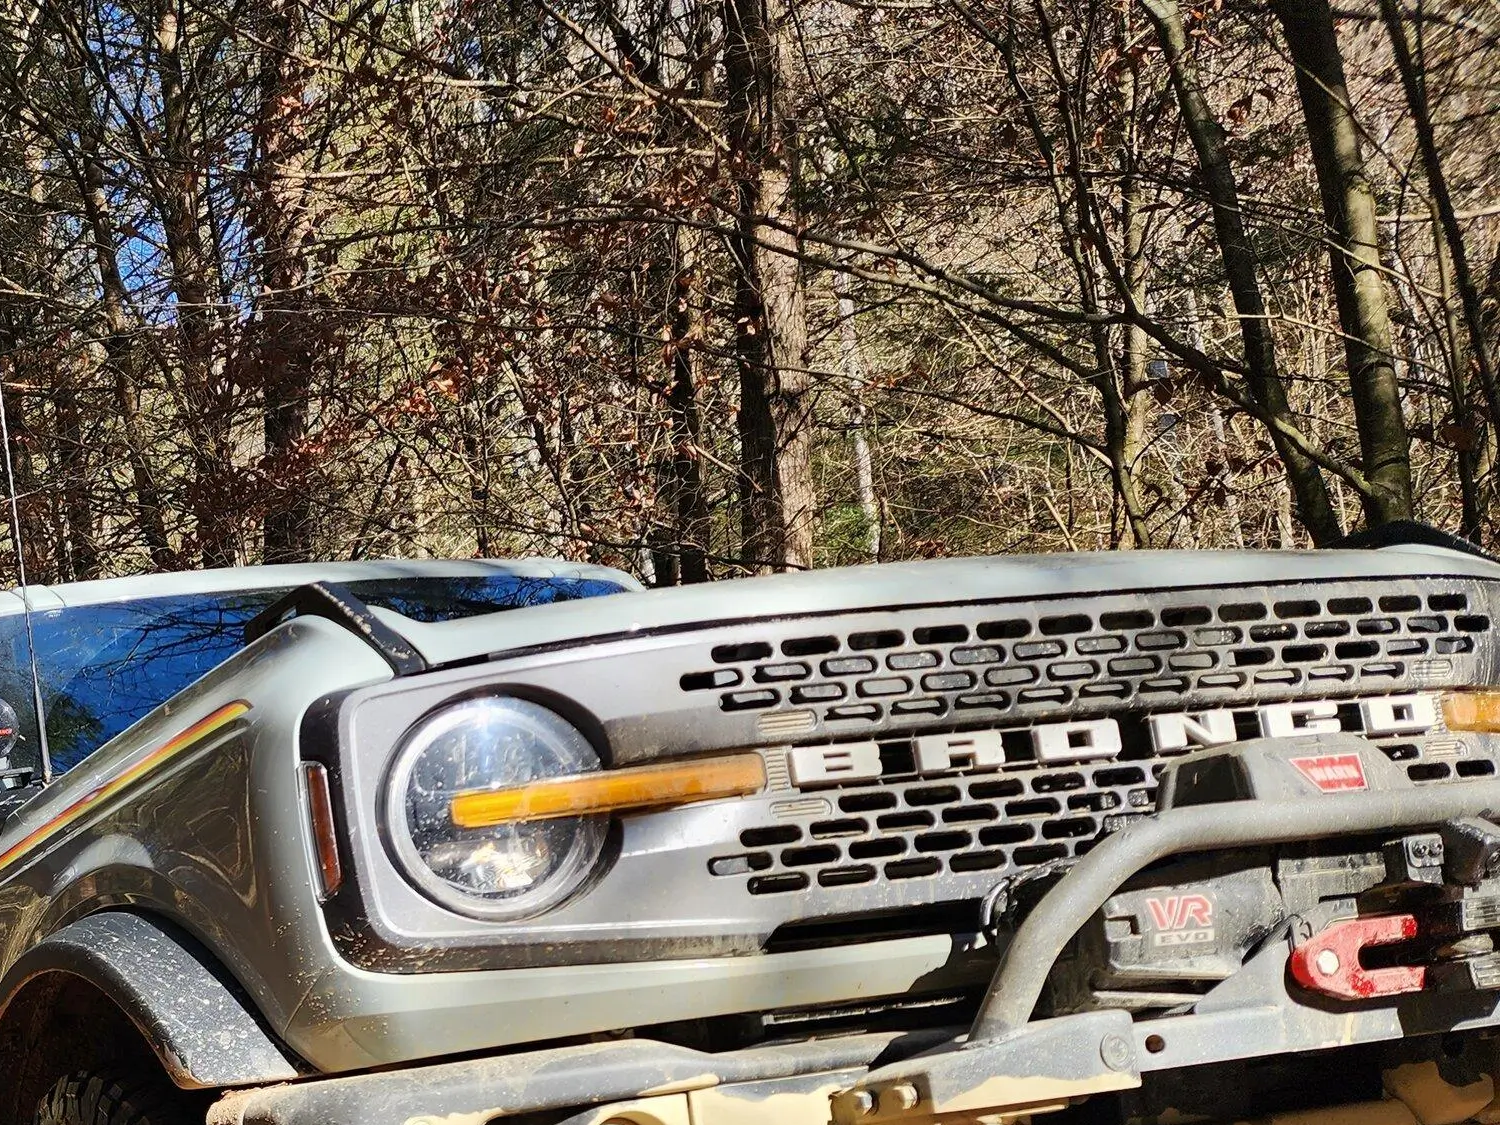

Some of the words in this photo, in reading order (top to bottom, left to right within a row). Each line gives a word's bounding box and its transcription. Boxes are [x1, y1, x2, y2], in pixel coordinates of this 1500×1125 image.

[789, 694, 1442, 788] BRONCO
[1145, 894, 1212, 931] VR
[1159, 931, 1211, 944] EVO
